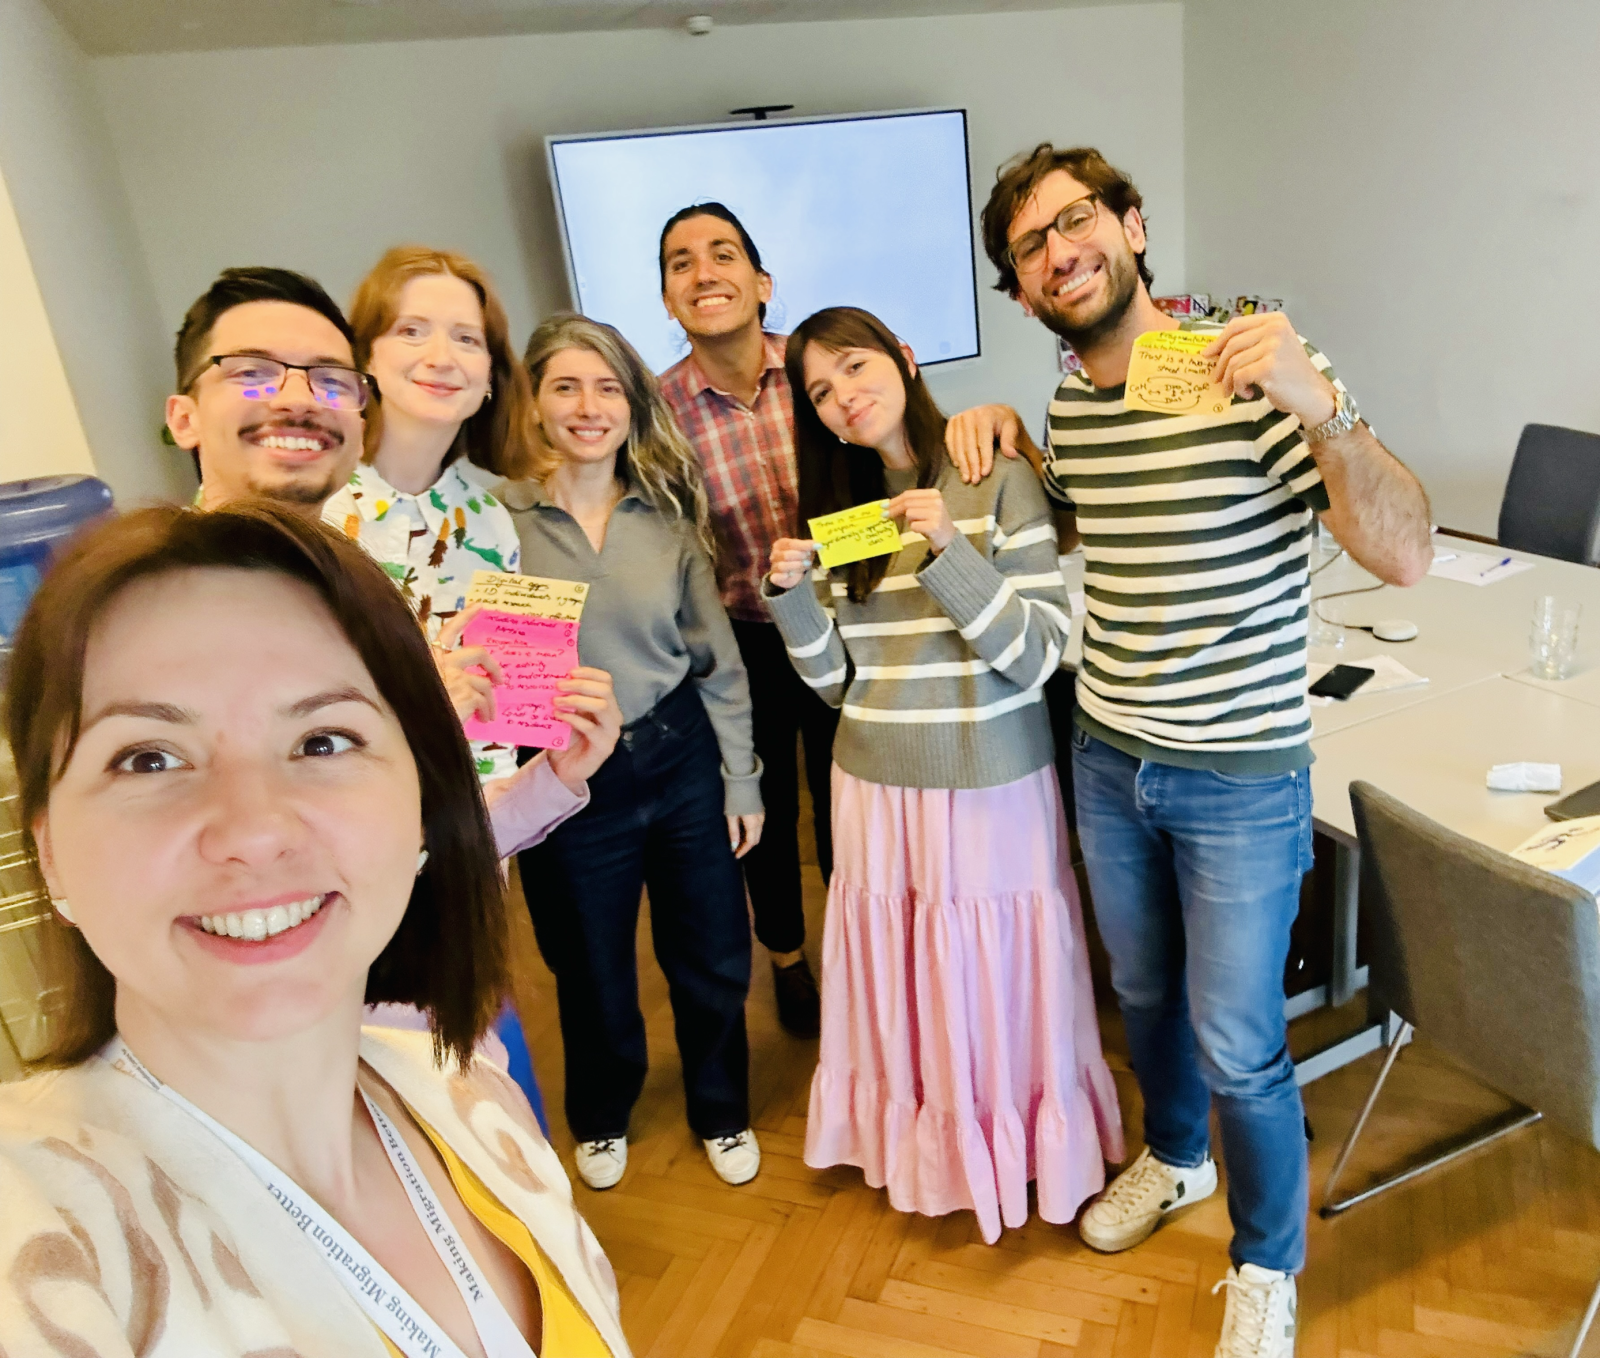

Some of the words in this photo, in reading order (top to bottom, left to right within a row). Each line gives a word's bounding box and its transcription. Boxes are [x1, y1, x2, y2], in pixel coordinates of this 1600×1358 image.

[1138, 351, 1162, 360] Trust
[486, 574, 524, 587] Digital
[369, 1102, 399, 1150] Better
[266, 1182, 314, 1233] Better
[397, 1151, 445, 1236] Migration
[312, 1222, 388, 1306] Migration
[444, 1235, 484, 1303] Making
[386, 1295, 442, 1358] Making
